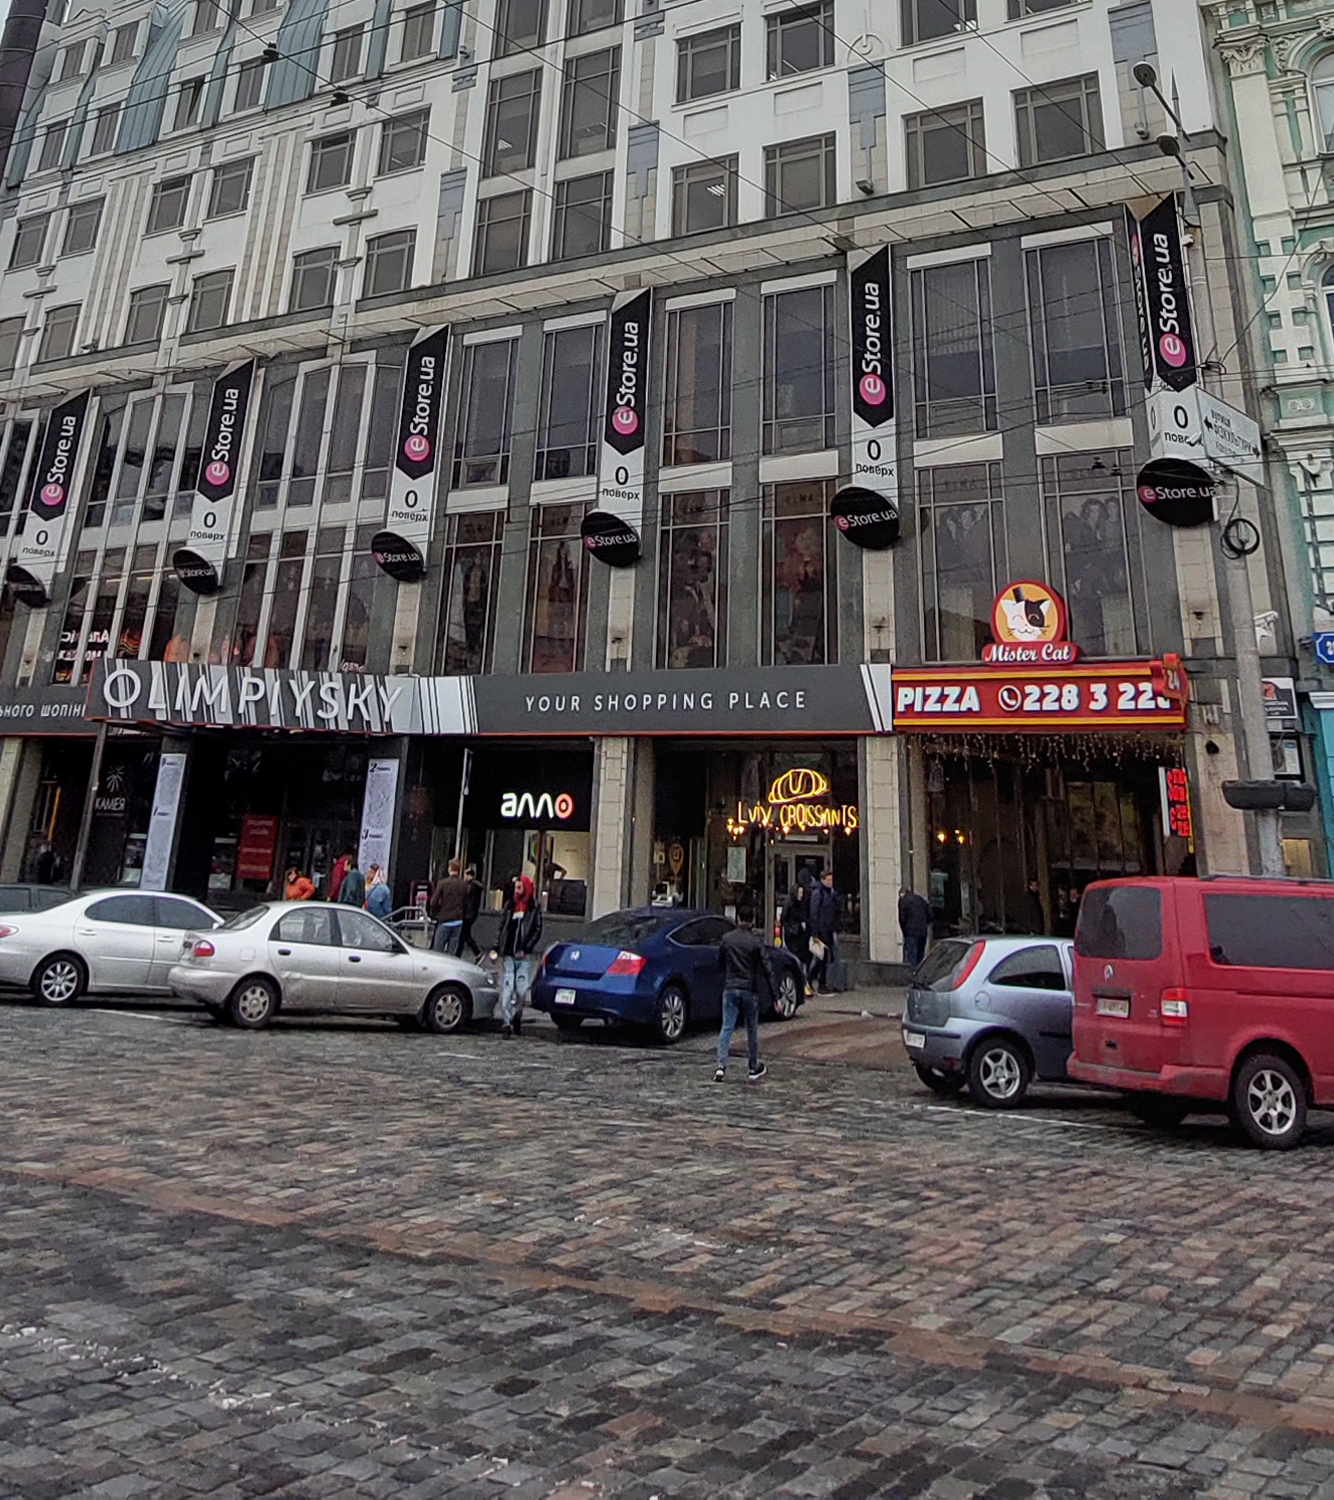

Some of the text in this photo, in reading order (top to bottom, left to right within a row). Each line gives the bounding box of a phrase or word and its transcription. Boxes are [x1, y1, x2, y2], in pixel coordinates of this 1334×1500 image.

[1154, 233, 1181, 355] eStore.ua
[862, 282, 882, 394] eStore.ua
[616, 322, 639, 425] eStore.ua
[410, 356, 436, 452] eStore.ua
[1174, 405, 1188, 429] 0
[211, 388, 239, 477] eStore.ua
[47, 415, 76, 497] eStore.ua
[867, 439, 882, 460] 0
[615, 466, 629, 485] 0
[856, 463, 895, 478] поверх
[405, 490, 418, 508] 0
[602, 488, 640, 500] поверх
[203, 512, 217, 528] 0
[391, 510, 428, 522] поверх
[36, 530, 49, 545] 0
[190, 530, 225, 540] поверх
[985, 644, 1070, 663] Mister Cat
[103, 668, 404, 724] OLIMPIYSKY
[525, 690, 806, 712] YOUR SHOPPING PLACE
[897, 686, 980, 712] PIZZA
[1023, 684, 1079, 712] 228
[1088, 683, 1108, 710] 3
